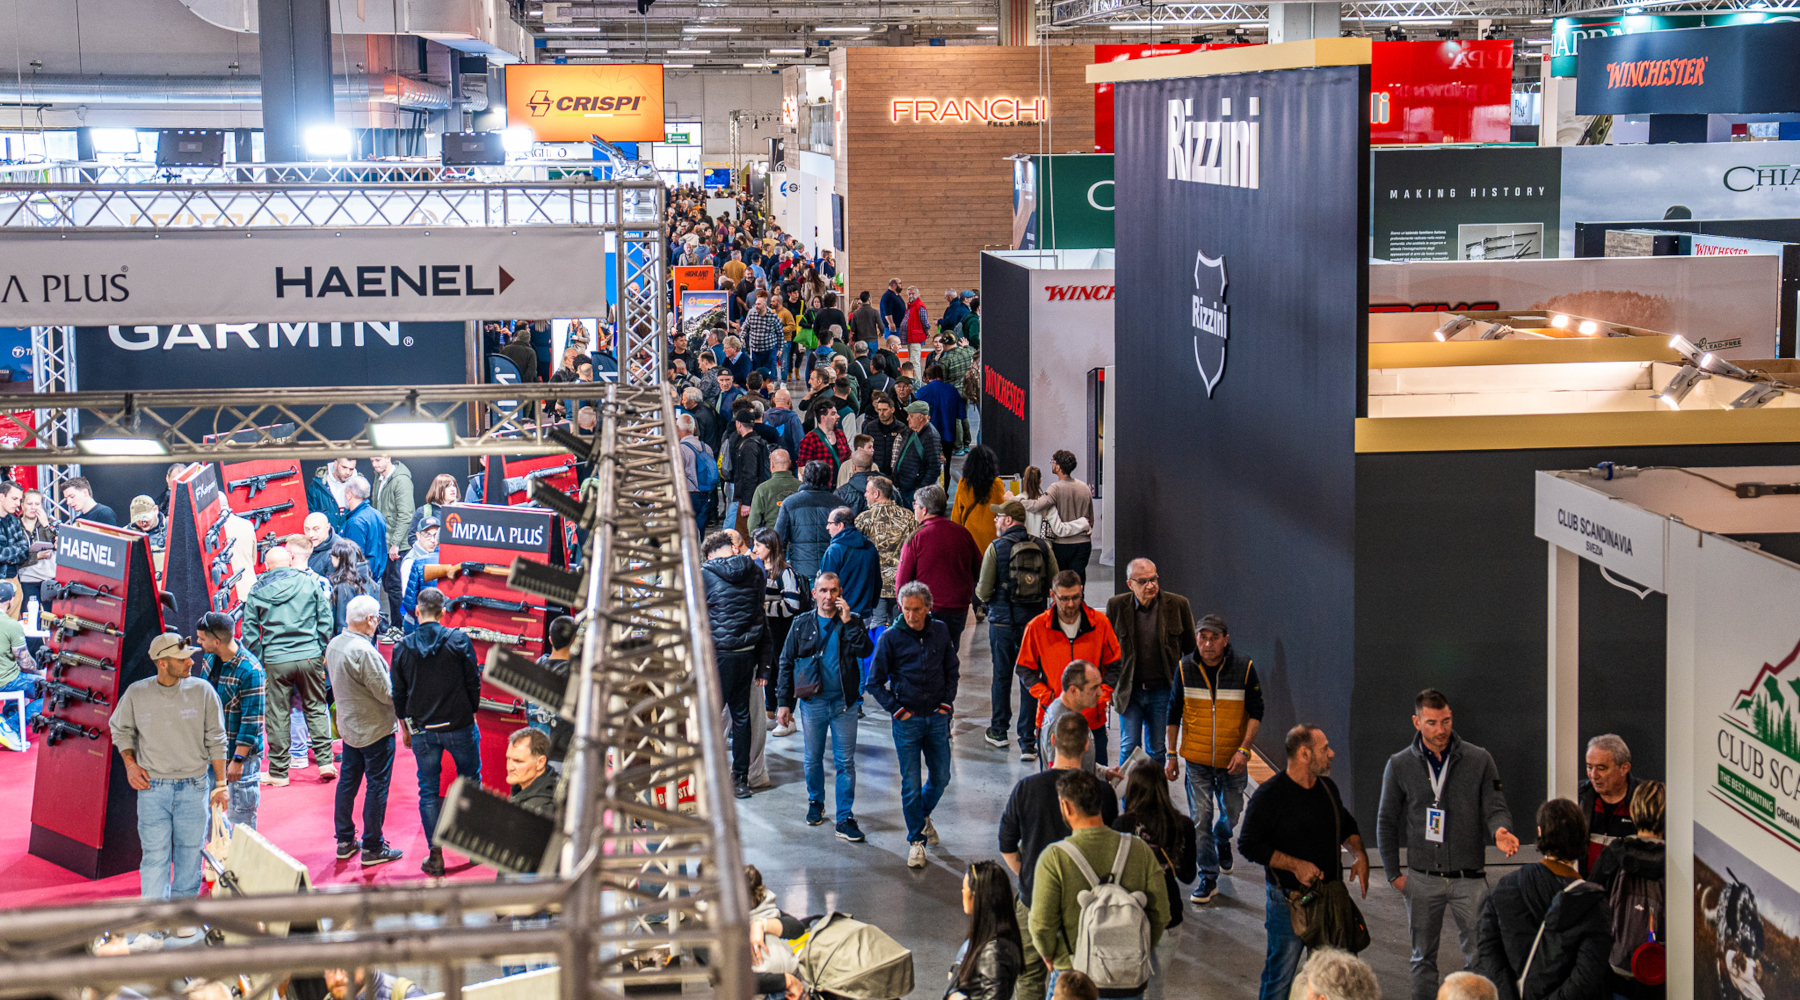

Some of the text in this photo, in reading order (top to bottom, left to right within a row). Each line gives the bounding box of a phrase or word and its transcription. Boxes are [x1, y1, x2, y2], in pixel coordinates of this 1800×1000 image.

[1606, 57, 1706, 89] WINCHESTER
[892, 98, 1046, 122] FRANCHI
[1167, 96, 1260, 189] Rizzini
[1389, 186, 1544, 199] MAKING HISTORY
[275, 265, 495, 298] HAENEL
[1192, 294, 1228, 339] Rizzini
[984, 364, 1026, 421] WINCHESTER
[451, 522, 506, 542] IMPALA
[1557, 508, 1634, 556] CLUB SCANDINAVIA
[59, 536, 116, 568] HAENEL
[1717, 729, 1764, 779] CLUB
[1719, 770, 1800, 830] THE BEST HUNTING ORGAN
